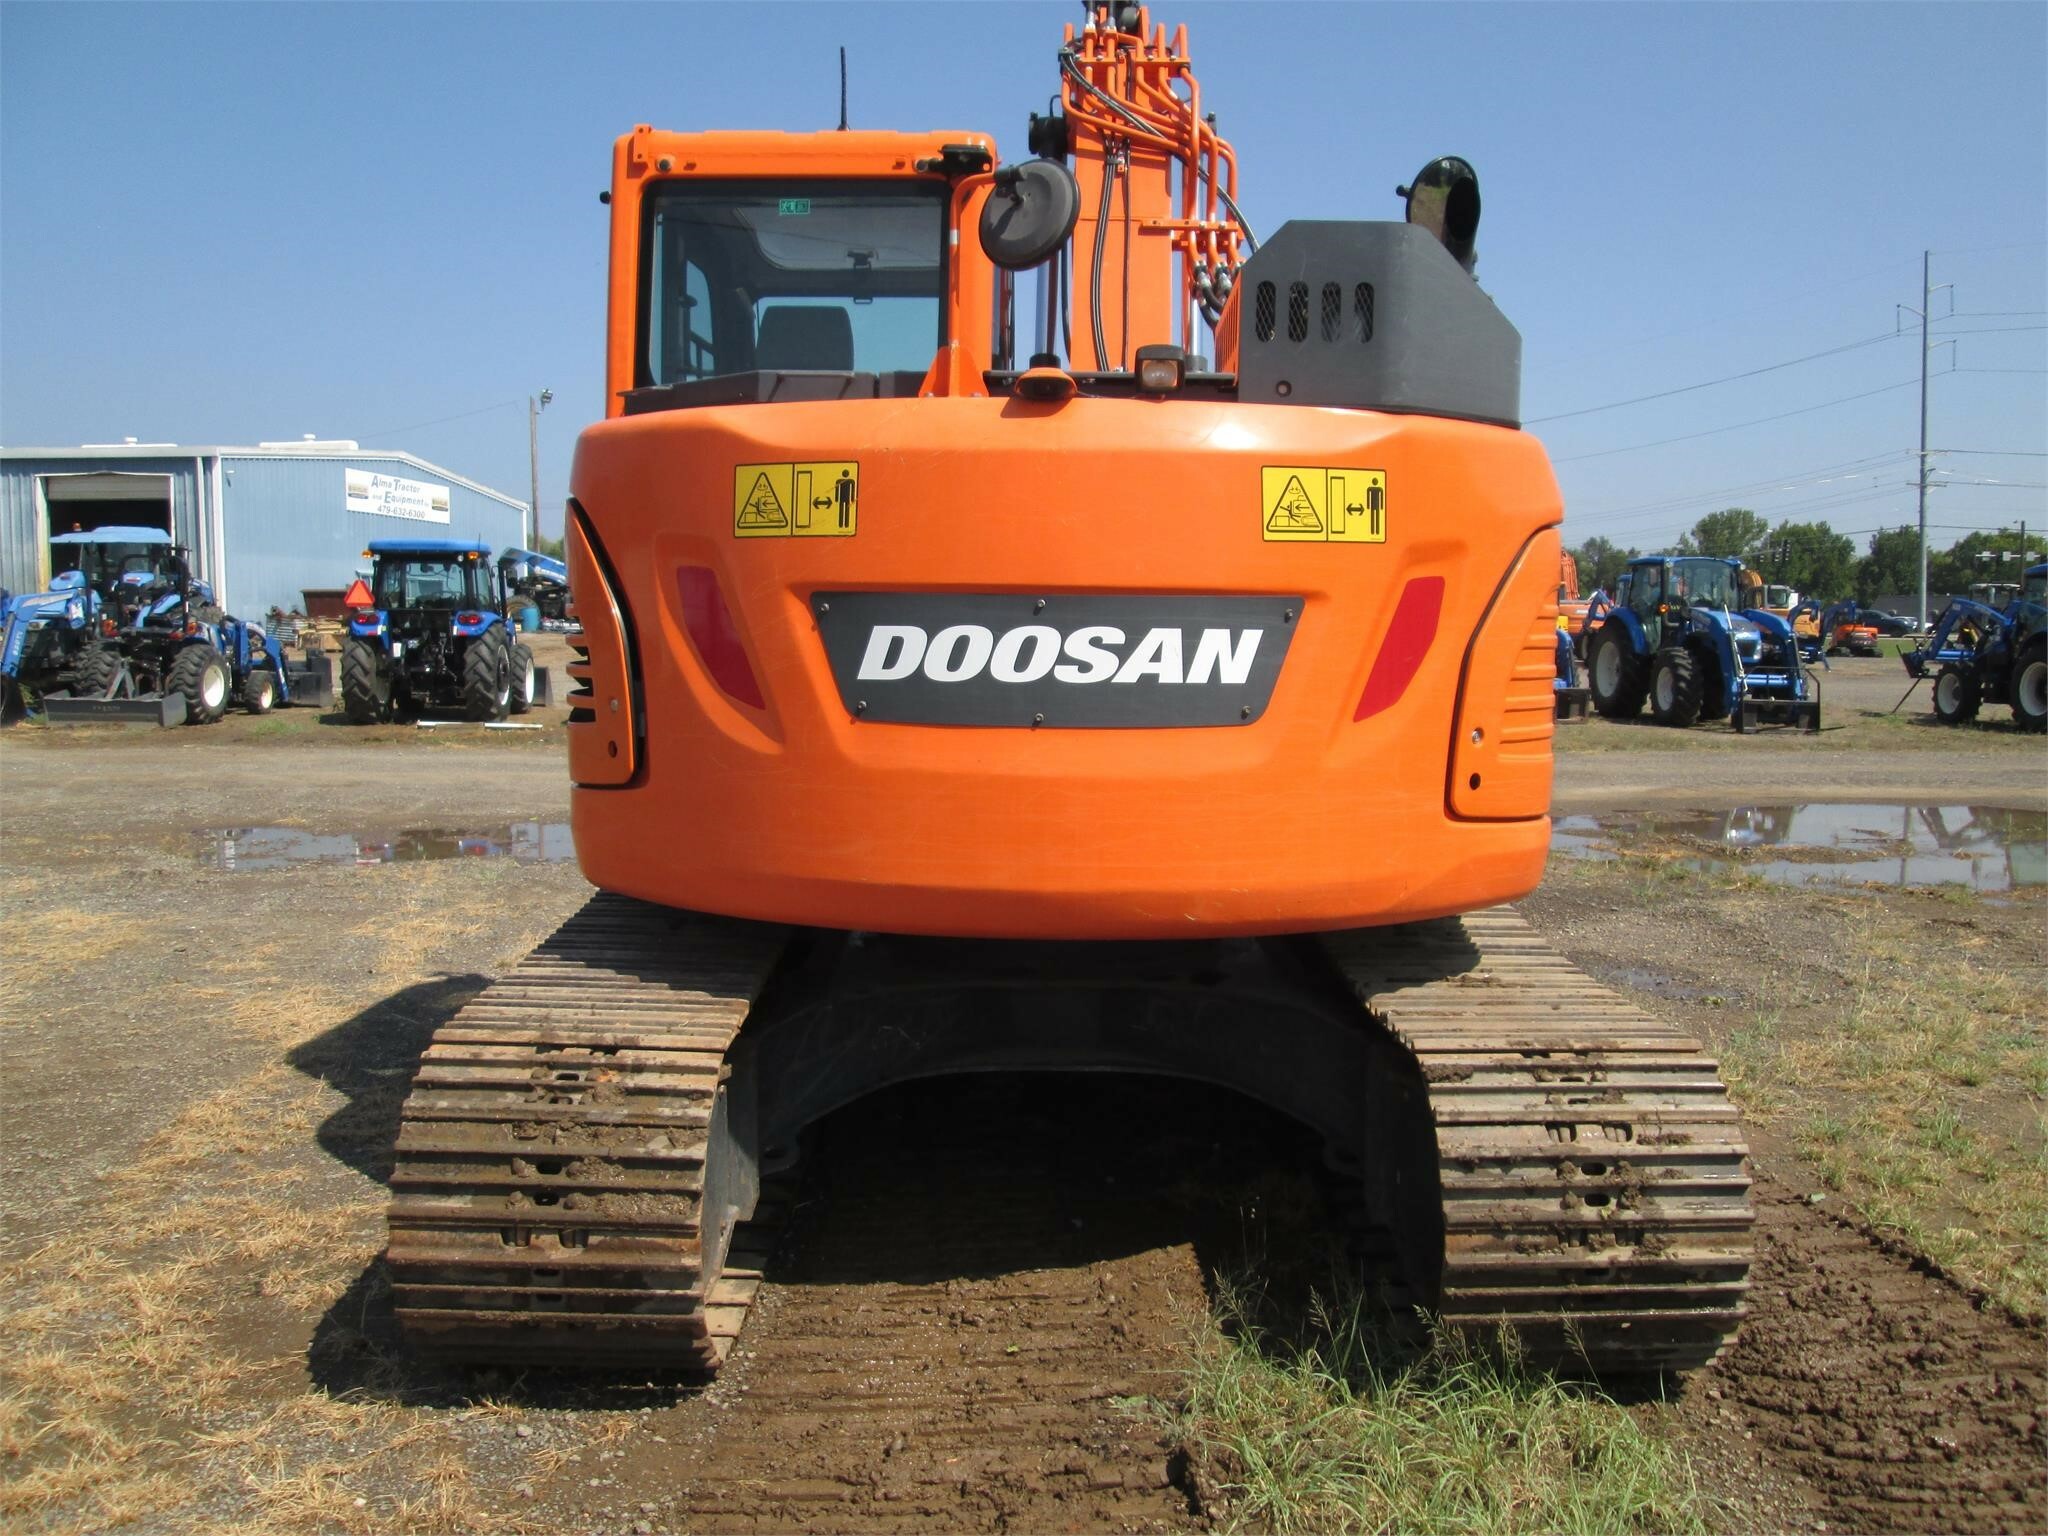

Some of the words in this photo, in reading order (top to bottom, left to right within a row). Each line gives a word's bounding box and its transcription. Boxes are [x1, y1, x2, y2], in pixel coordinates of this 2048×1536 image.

[371, 475, 392, 488] Alma
[393, 479, 421, 493] Tractor
[384, 491, 424, 506] Equipment
[377, 505, 426, 519] 479-632-6300
[856, 624, 1264, 685] DOOSAN
